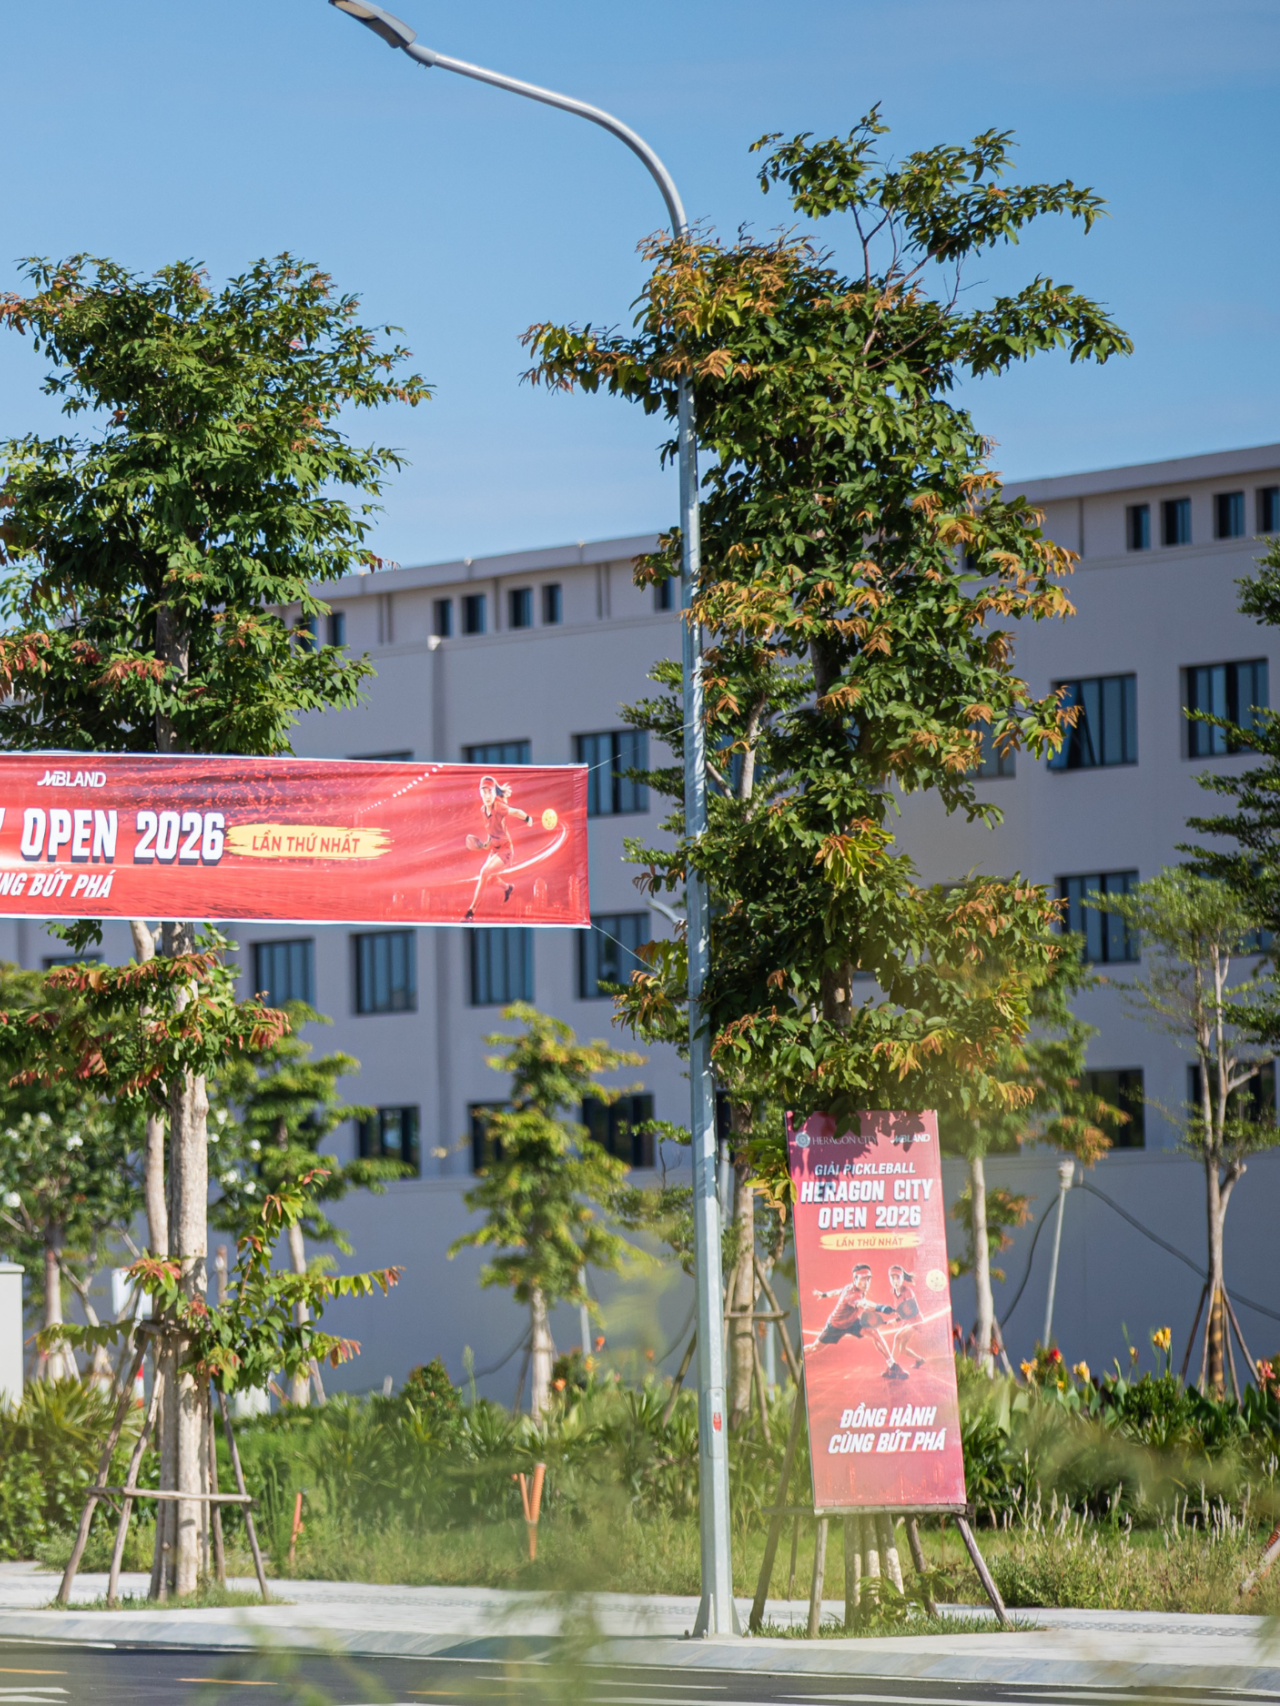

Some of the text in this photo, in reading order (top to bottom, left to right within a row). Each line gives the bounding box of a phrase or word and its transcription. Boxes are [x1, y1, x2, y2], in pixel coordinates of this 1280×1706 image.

[37, 770, 107, 788] MBLAND
[20, 808, 118, 863] OPEN
[133, 811, 225, 866] 2026
[252, 830, 360, 853] LẦN THỨ NHẤT
[28, 868, 72, 896] BỨT
[71, 870, 116, 898] PHÁ
[812, 1136, 876, 1145] HERAGON CITY
[814, 1162, 916, 1176] GIẢI PICKLEBALL
[800, 1179, 933, 1204] HERAGON CITY
[818, 1206, 921, 1230] OPEN 2026
[840, 1402, 937, 1428] ĐỒNG HÀNH
[828, 1428, 946, 1454] CÙNG BỨT PHÁ
